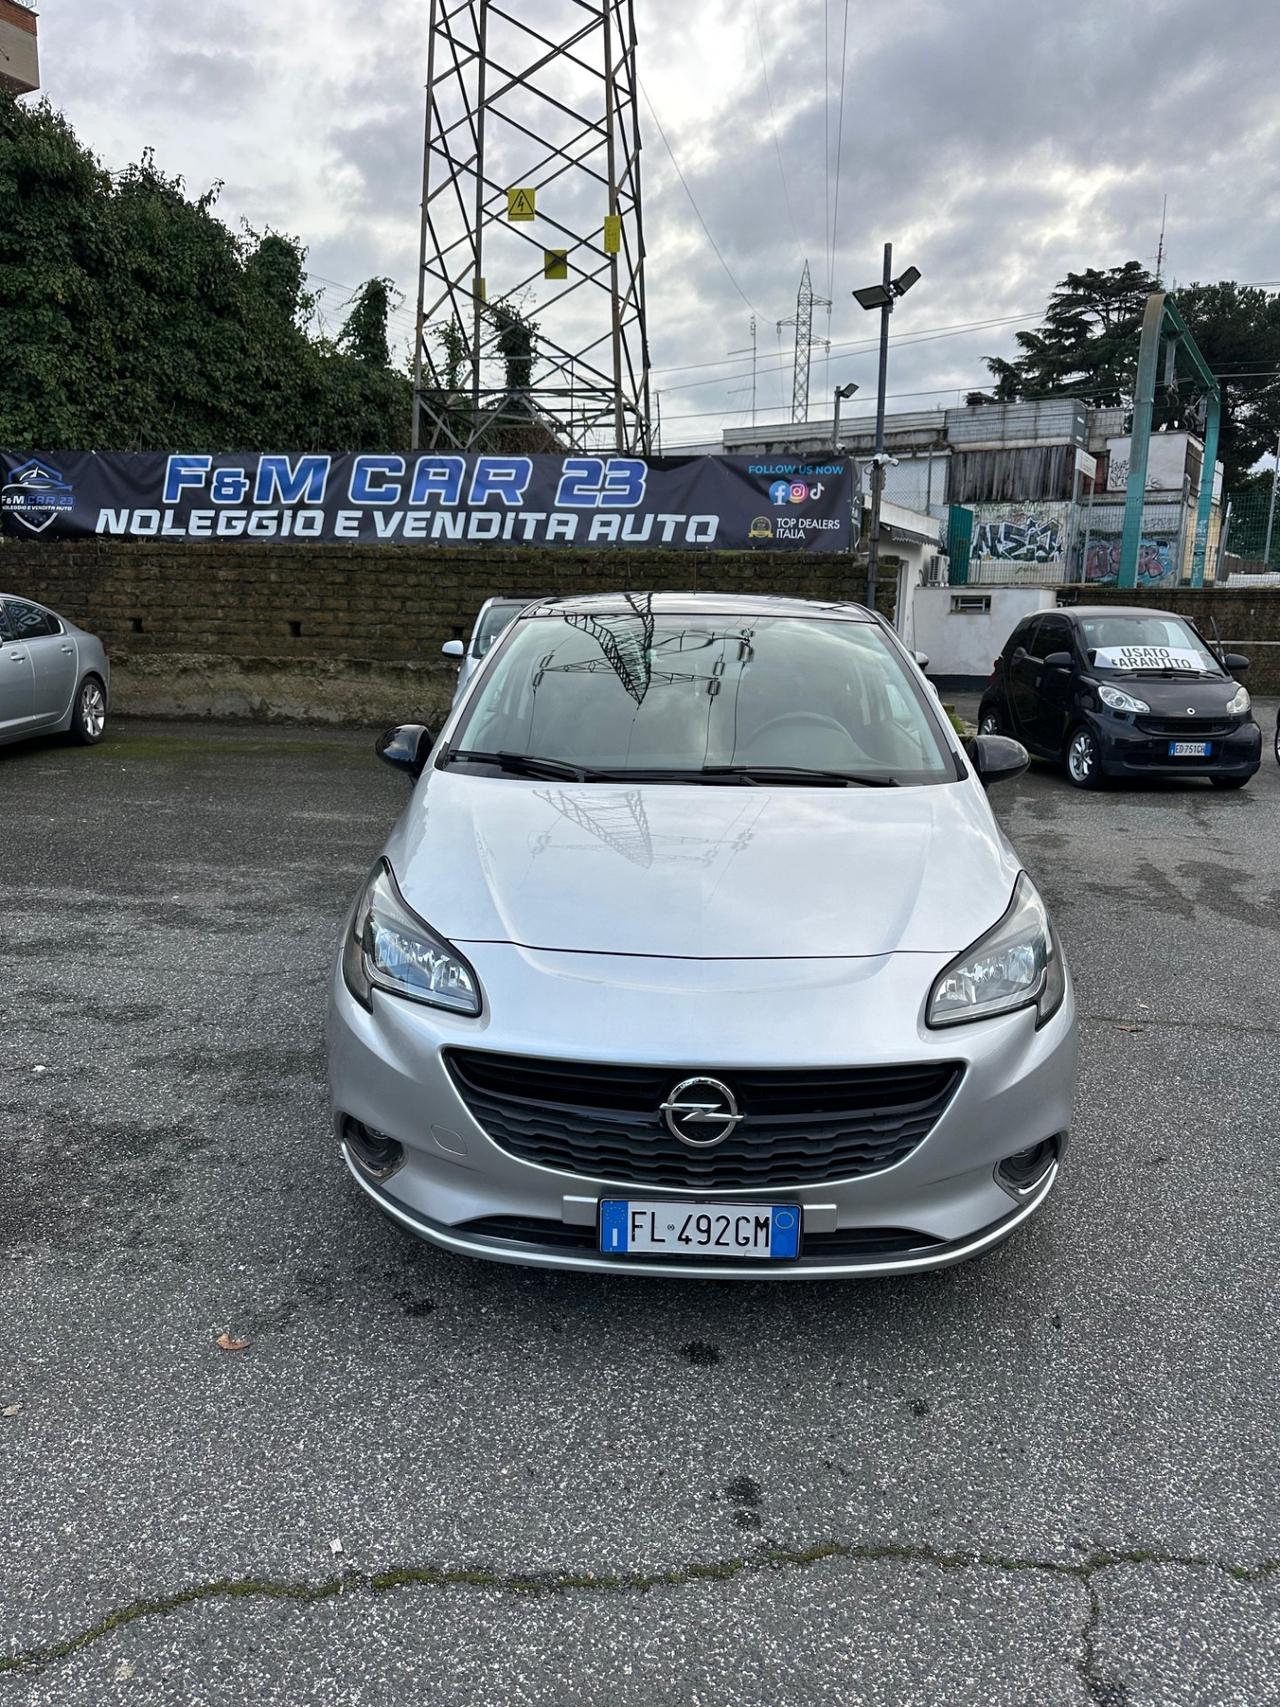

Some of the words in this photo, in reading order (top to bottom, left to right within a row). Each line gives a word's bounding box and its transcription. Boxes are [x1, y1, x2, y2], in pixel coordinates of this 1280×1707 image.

[748, 464, 795, 474] FOLLOW
[799, 465, 813, 474] US
[815, 465, 844, 475] NOW
[162, 454, 332, 505] F&M
[347, 455, 534, 507] CAR
[554, 457, 648, 508] 23
[27, 495, 56, 505] CAR
[59, 495, 74, 505] 23
[96, 507, 325, 537] NOLEGGIO
[334, 510, 363, 537] E
[373, 510, 581, 541] VENDITA
[587, 513, 720, 543] AUTO
[776, 518, 797, 528] TOP
[798, 518, 840, 529] DEALERS
[776, 529, 806, 539] ITALIA
[1120, 647, 1170, 658] USATO
